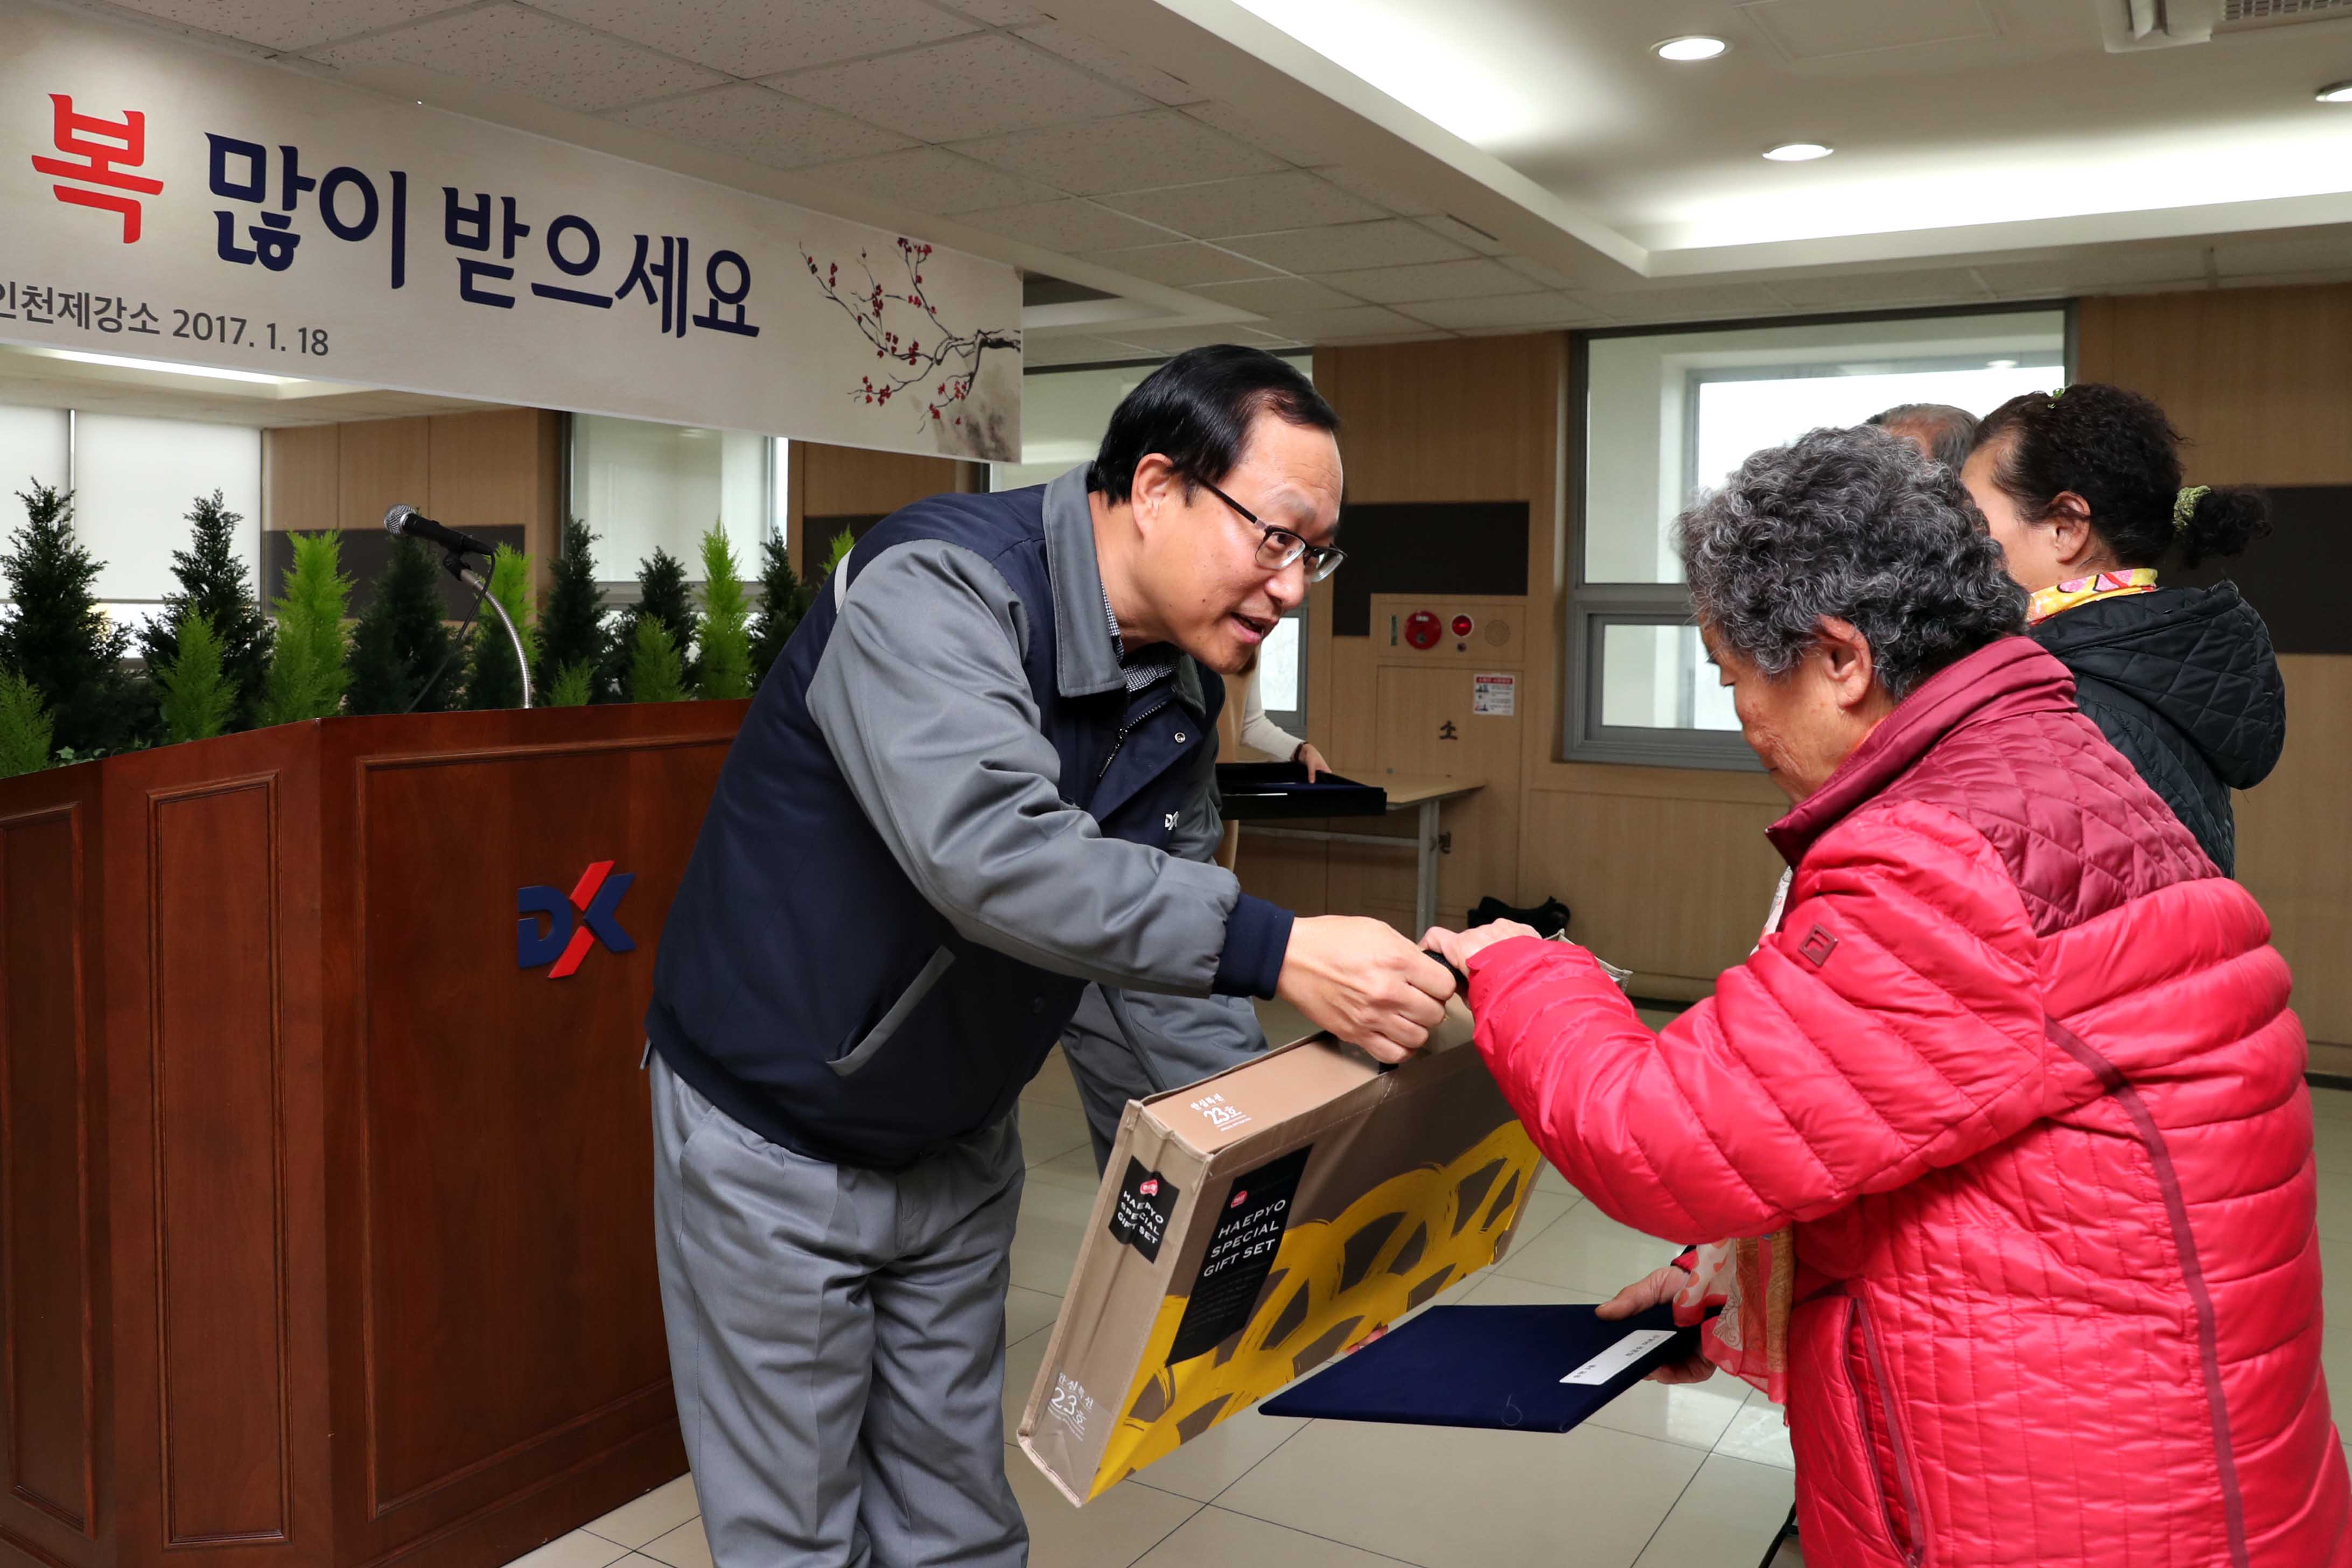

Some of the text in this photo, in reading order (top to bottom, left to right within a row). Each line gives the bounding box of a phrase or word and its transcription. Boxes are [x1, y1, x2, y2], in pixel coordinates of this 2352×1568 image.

[32, 93, 760, 339] 복 많이 받으세요
[0, 281, 328, 356] 인천제강소 2017. 1. 18
[1121, 1201, 1160, 1236] SPECIAL
[1124, 1191, 1164, 1224] HAEPYO
[1218, 1199, 1286, 1239] HAEPYO
[1117, 1212, 1158, 1244] GIFT SET
[1210, 1220, 1279, 1258] SPECIAL
[1203, 1238, 1276, 1277] GIFT SET
